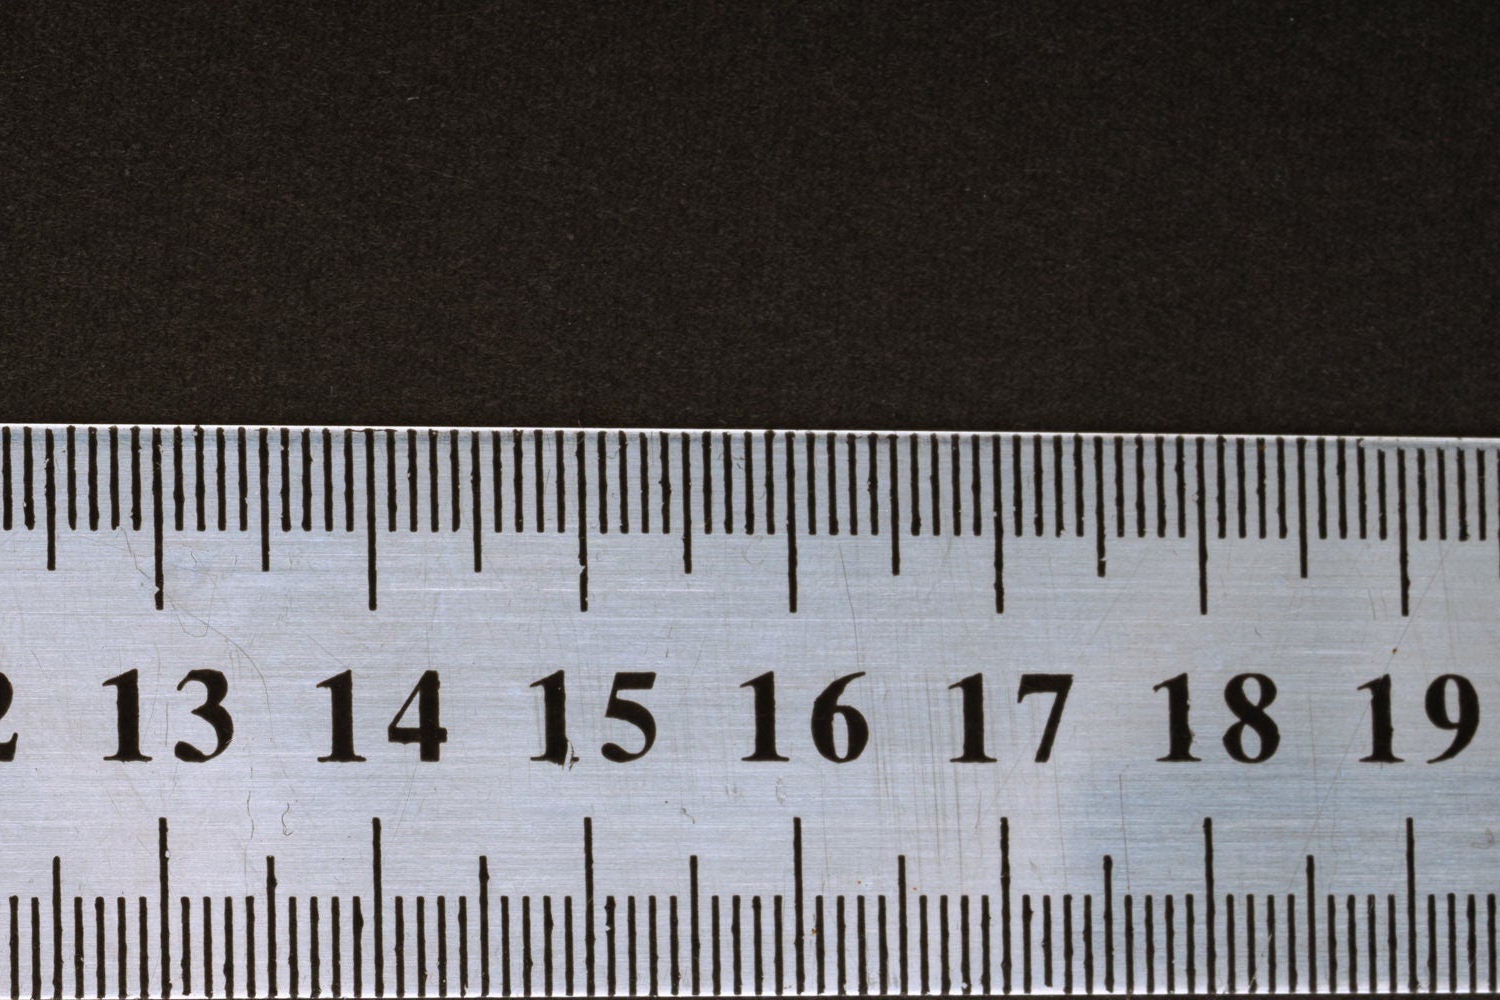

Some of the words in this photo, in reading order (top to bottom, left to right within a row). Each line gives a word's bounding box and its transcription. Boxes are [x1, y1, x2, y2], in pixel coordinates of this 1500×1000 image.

[102, 668, 234, 763] 13
[316, 669, 448, 763] 14
[529, 669, 657, 766] 15
[740, 670, 869, 764] 16
[948, 672, 1074, 763] 17
[1152, 672, 1281, 764] 18
[1357, 673, 1480, 764] 19
